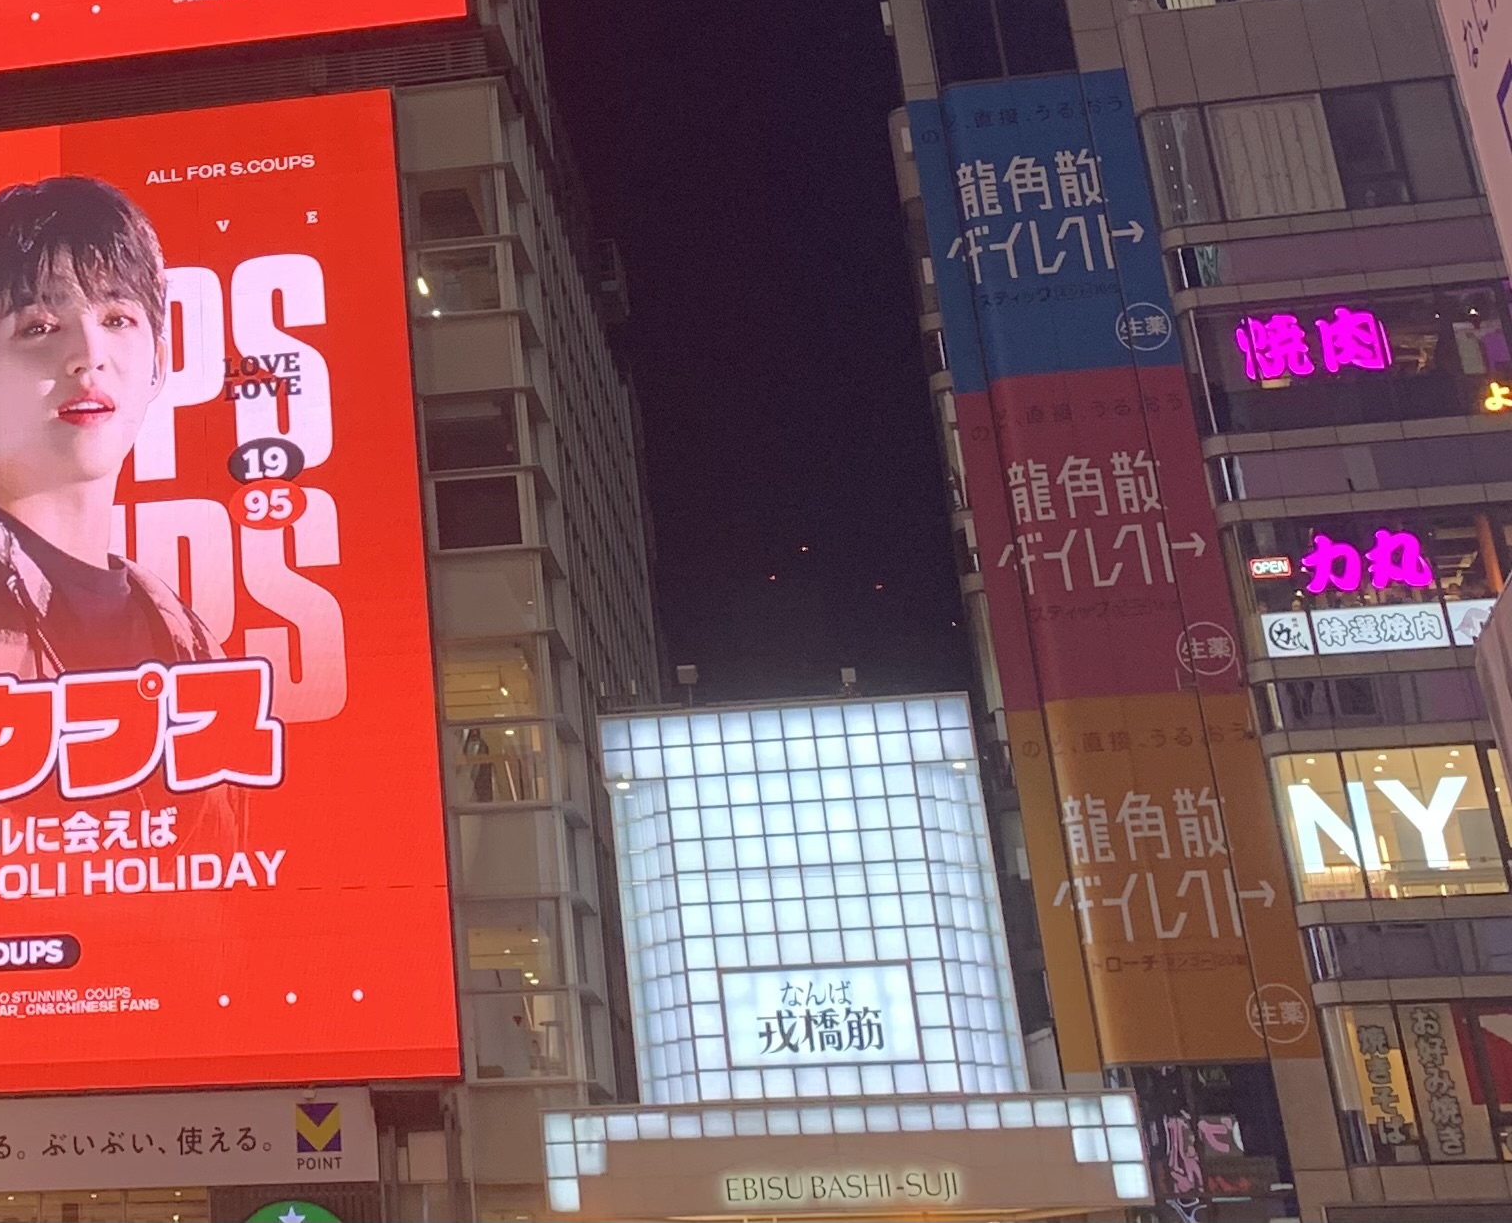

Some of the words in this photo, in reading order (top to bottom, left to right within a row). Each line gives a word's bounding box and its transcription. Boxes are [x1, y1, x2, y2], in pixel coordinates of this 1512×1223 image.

[145, 168, 183, 185] ALL
[187, 163, 226, 181] FOR
[230, 153, 315, 176] S.COUPS
[957, 149, 1109, 220] 龍角散
[216, 219, 230, 233] V
[305, 211, 318, 224] E
[1236, 307, 1392, 380] 焼肉
[224, 352, 300, 377] LOVE
[225, 375, 302, 401] LOVE
[243, 447, 288, 480] 19
[244, 488, 293, 520] 95
[1008, 450, 1168, 525] 龍角散
[1253, 560, 1289, 574] OPEN
[1302, 528, 1433, 593] 力丸
[1317, 610, 1443, 647] 特選焼肉
[1061, 787, 1233, 866] 龍角散
[1287, 776, 1468, 873] NY
[83, 850, 286, 896] HOLIDAY
[120, 998, 159, 1011] FANS
[779, 979, 852, 1007] なんば
[758, 1005, 885, 1055] 戎橋筋
[1358, 1025, 1406, 1145] 焼きそば
[1410, 1006, 1465, 1156] お好み焼き
[41, 1125, 274, 1158] ぶいぶい、使える。
[296, 1156, 343, 1171] POINT
[727, 1174, 805, 1202] EBISU
